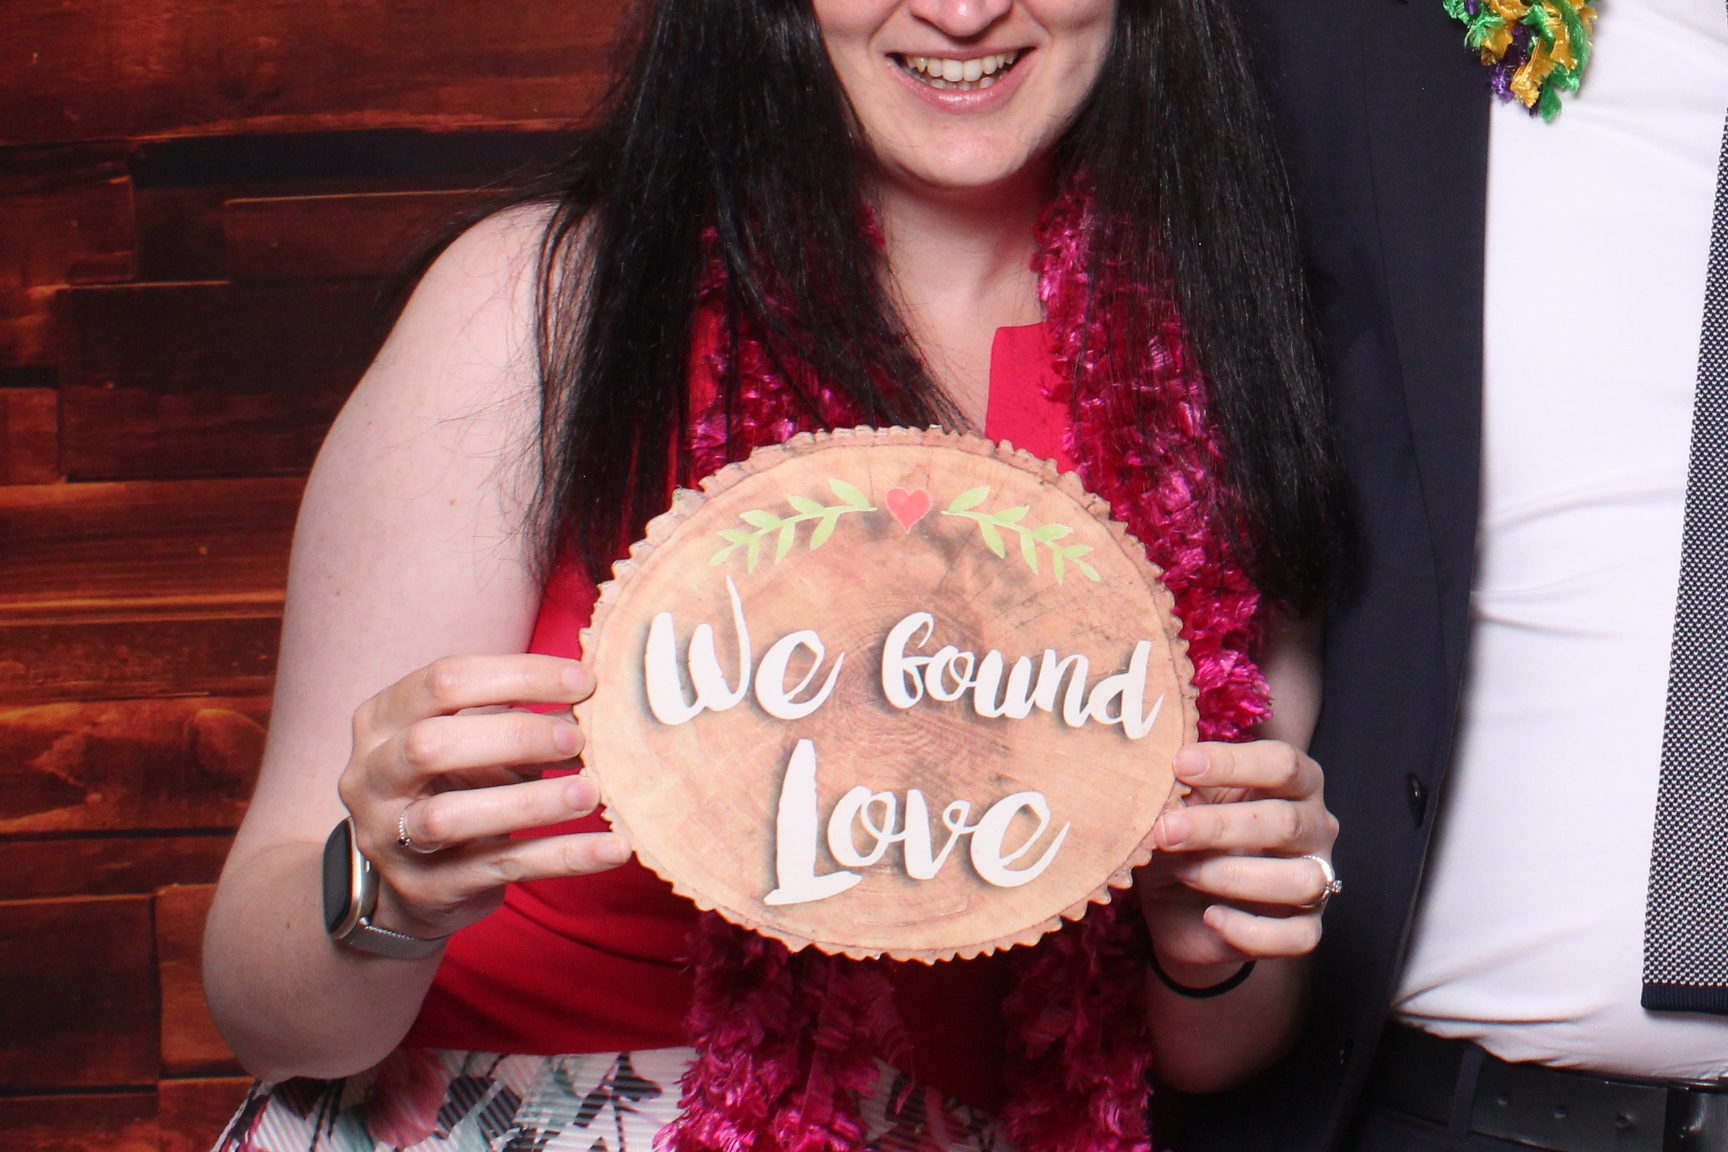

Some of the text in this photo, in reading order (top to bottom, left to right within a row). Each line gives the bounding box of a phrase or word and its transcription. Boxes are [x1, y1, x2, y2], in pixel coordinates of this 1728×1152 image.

[645, 574, 1165, 740] We found
[763, 737, 1072, 907] Love
